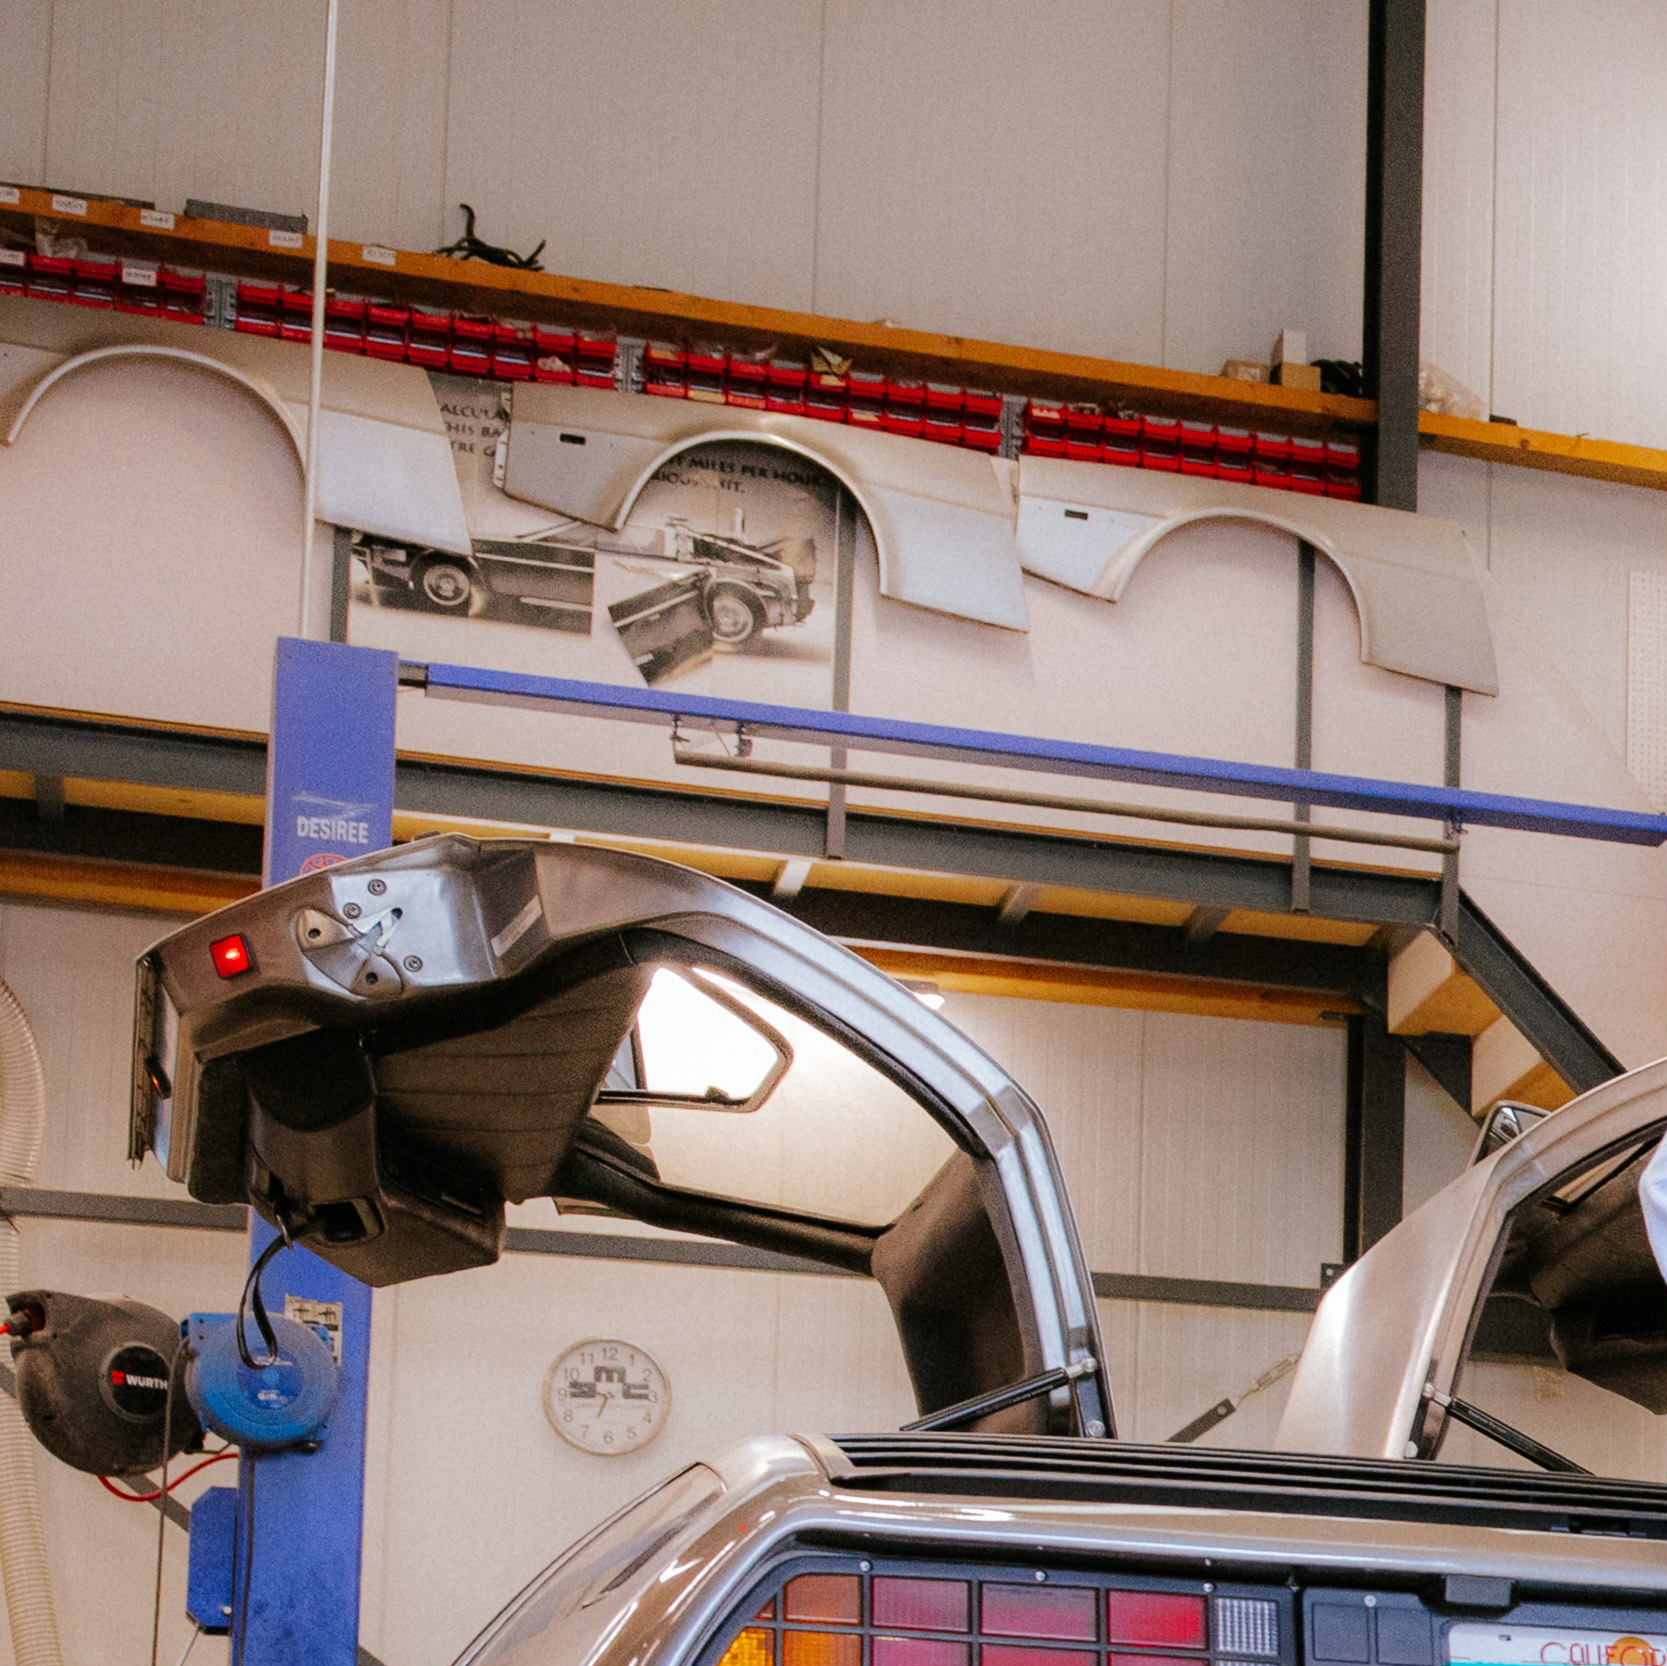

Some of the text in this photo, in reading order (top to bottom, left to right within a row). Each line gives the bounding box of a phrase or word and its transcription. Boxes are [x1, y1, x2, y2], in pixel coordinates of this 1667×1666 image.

[688, 457, 736, 473] MILES
[741, 464, 769, 479] PER
[296, 815, 369, 844] DESIREE
[581, 1352, 594, 1364] 11
[602, 1347, 618, 1361] 12
[563, 1368, 579, 1381] 10
[557, 1387, 567, 1401] 9
[563, 1409, 574, 1422] 8
[581, 1424, 590, 1438] 7
[603, 1430, 613, 1444] 6
[626, 1426, 637, 1439] 5
